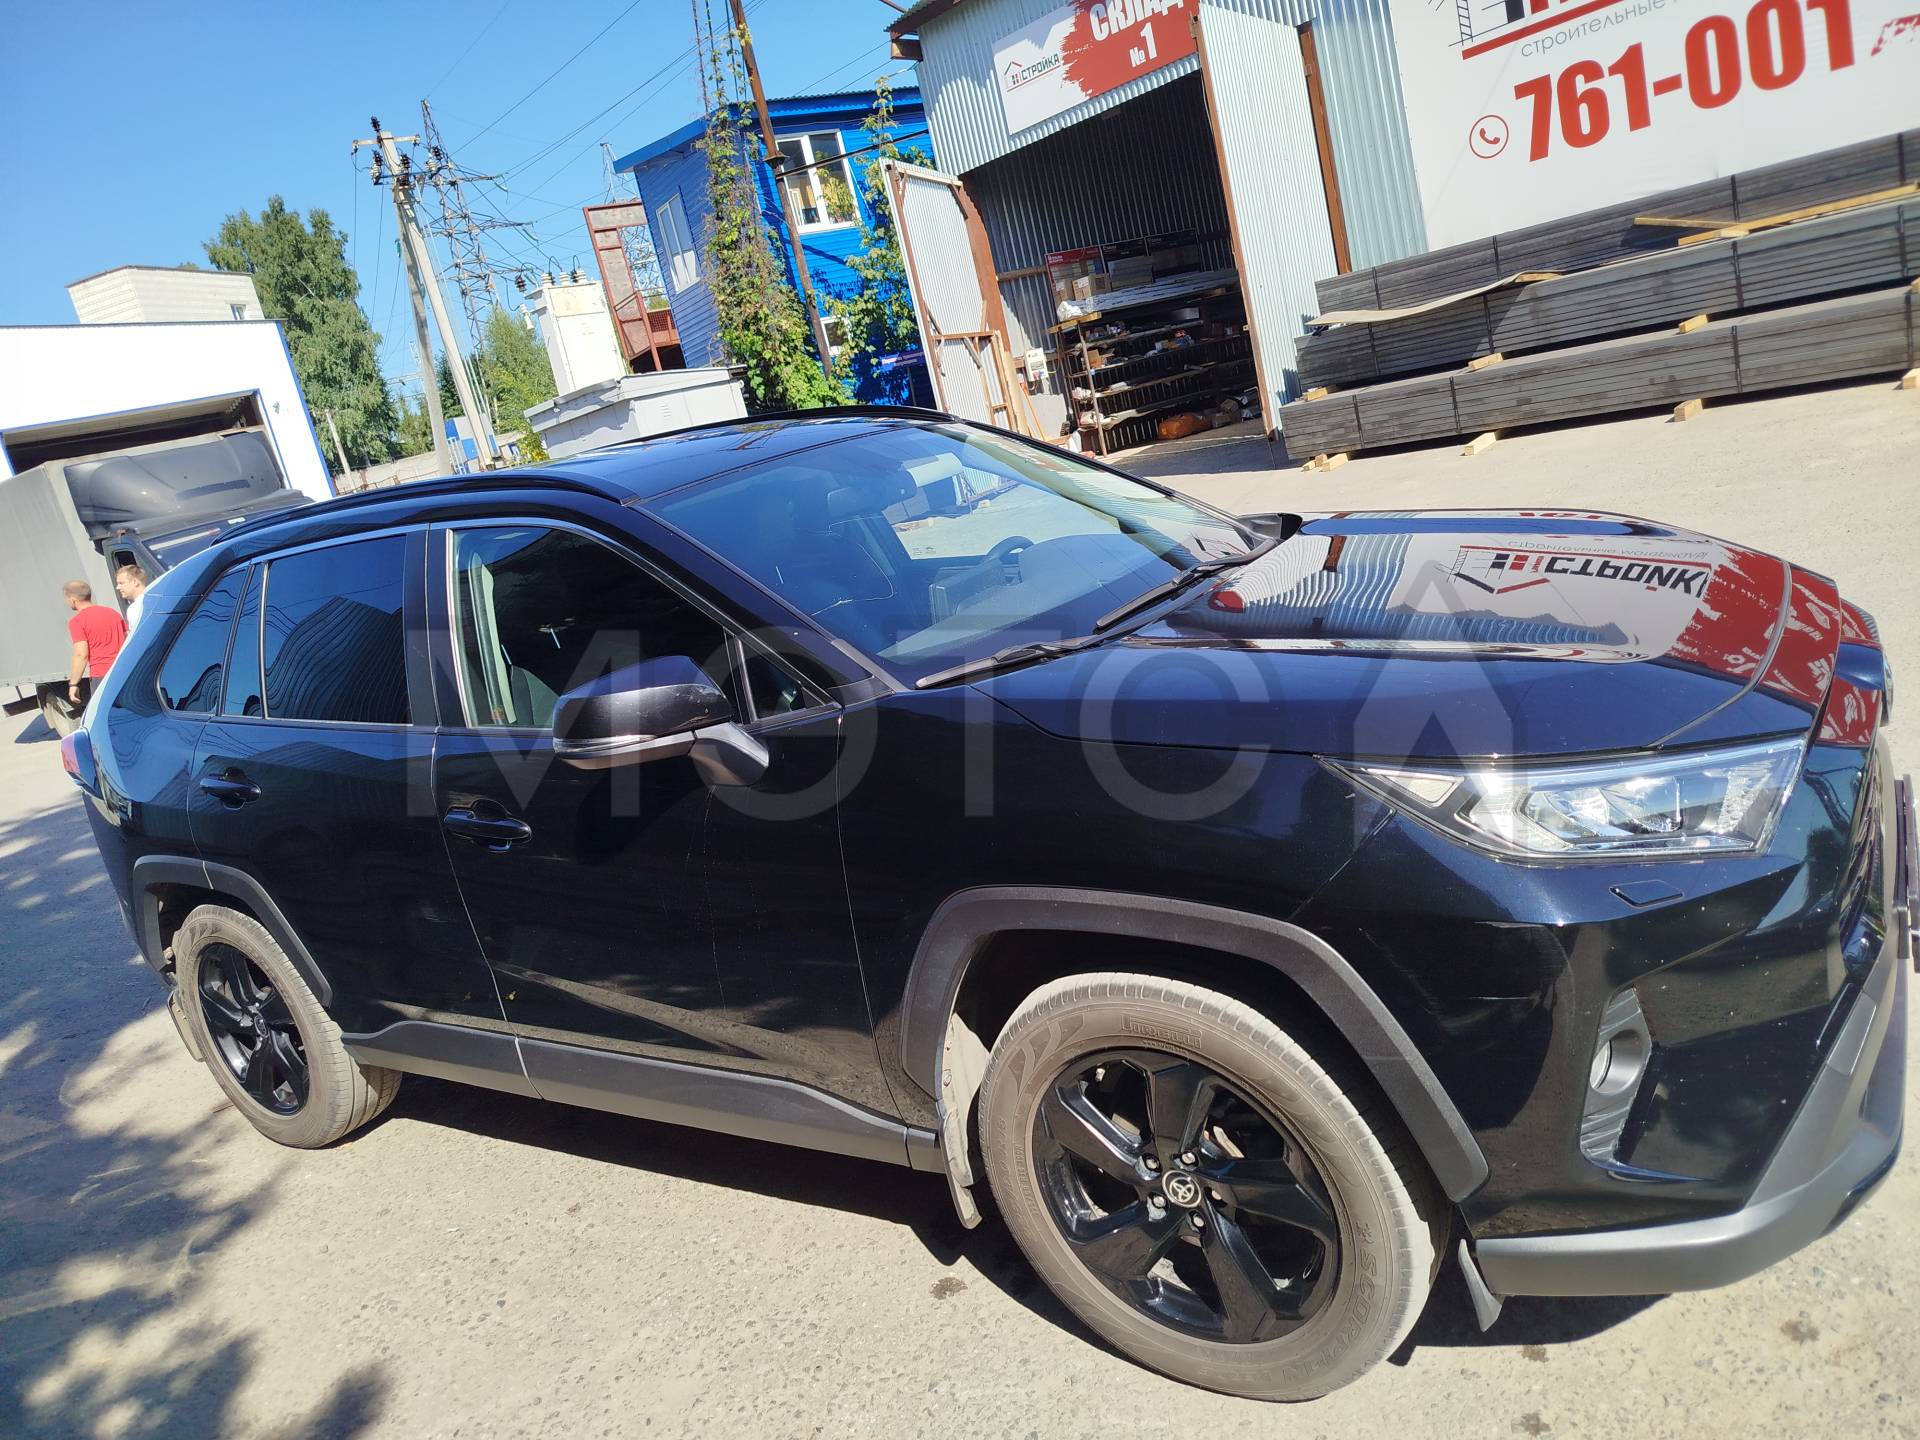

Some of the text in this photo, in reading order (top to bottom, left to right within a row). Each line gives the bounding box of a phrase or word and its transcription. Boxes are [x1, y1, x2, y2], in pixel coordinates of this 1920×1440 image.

[1521, 0, 1666, 57] строительные
[1020, 52, 1060, 81] СТРОЙКА
[1513, 0, 1856, 162] 761-001
